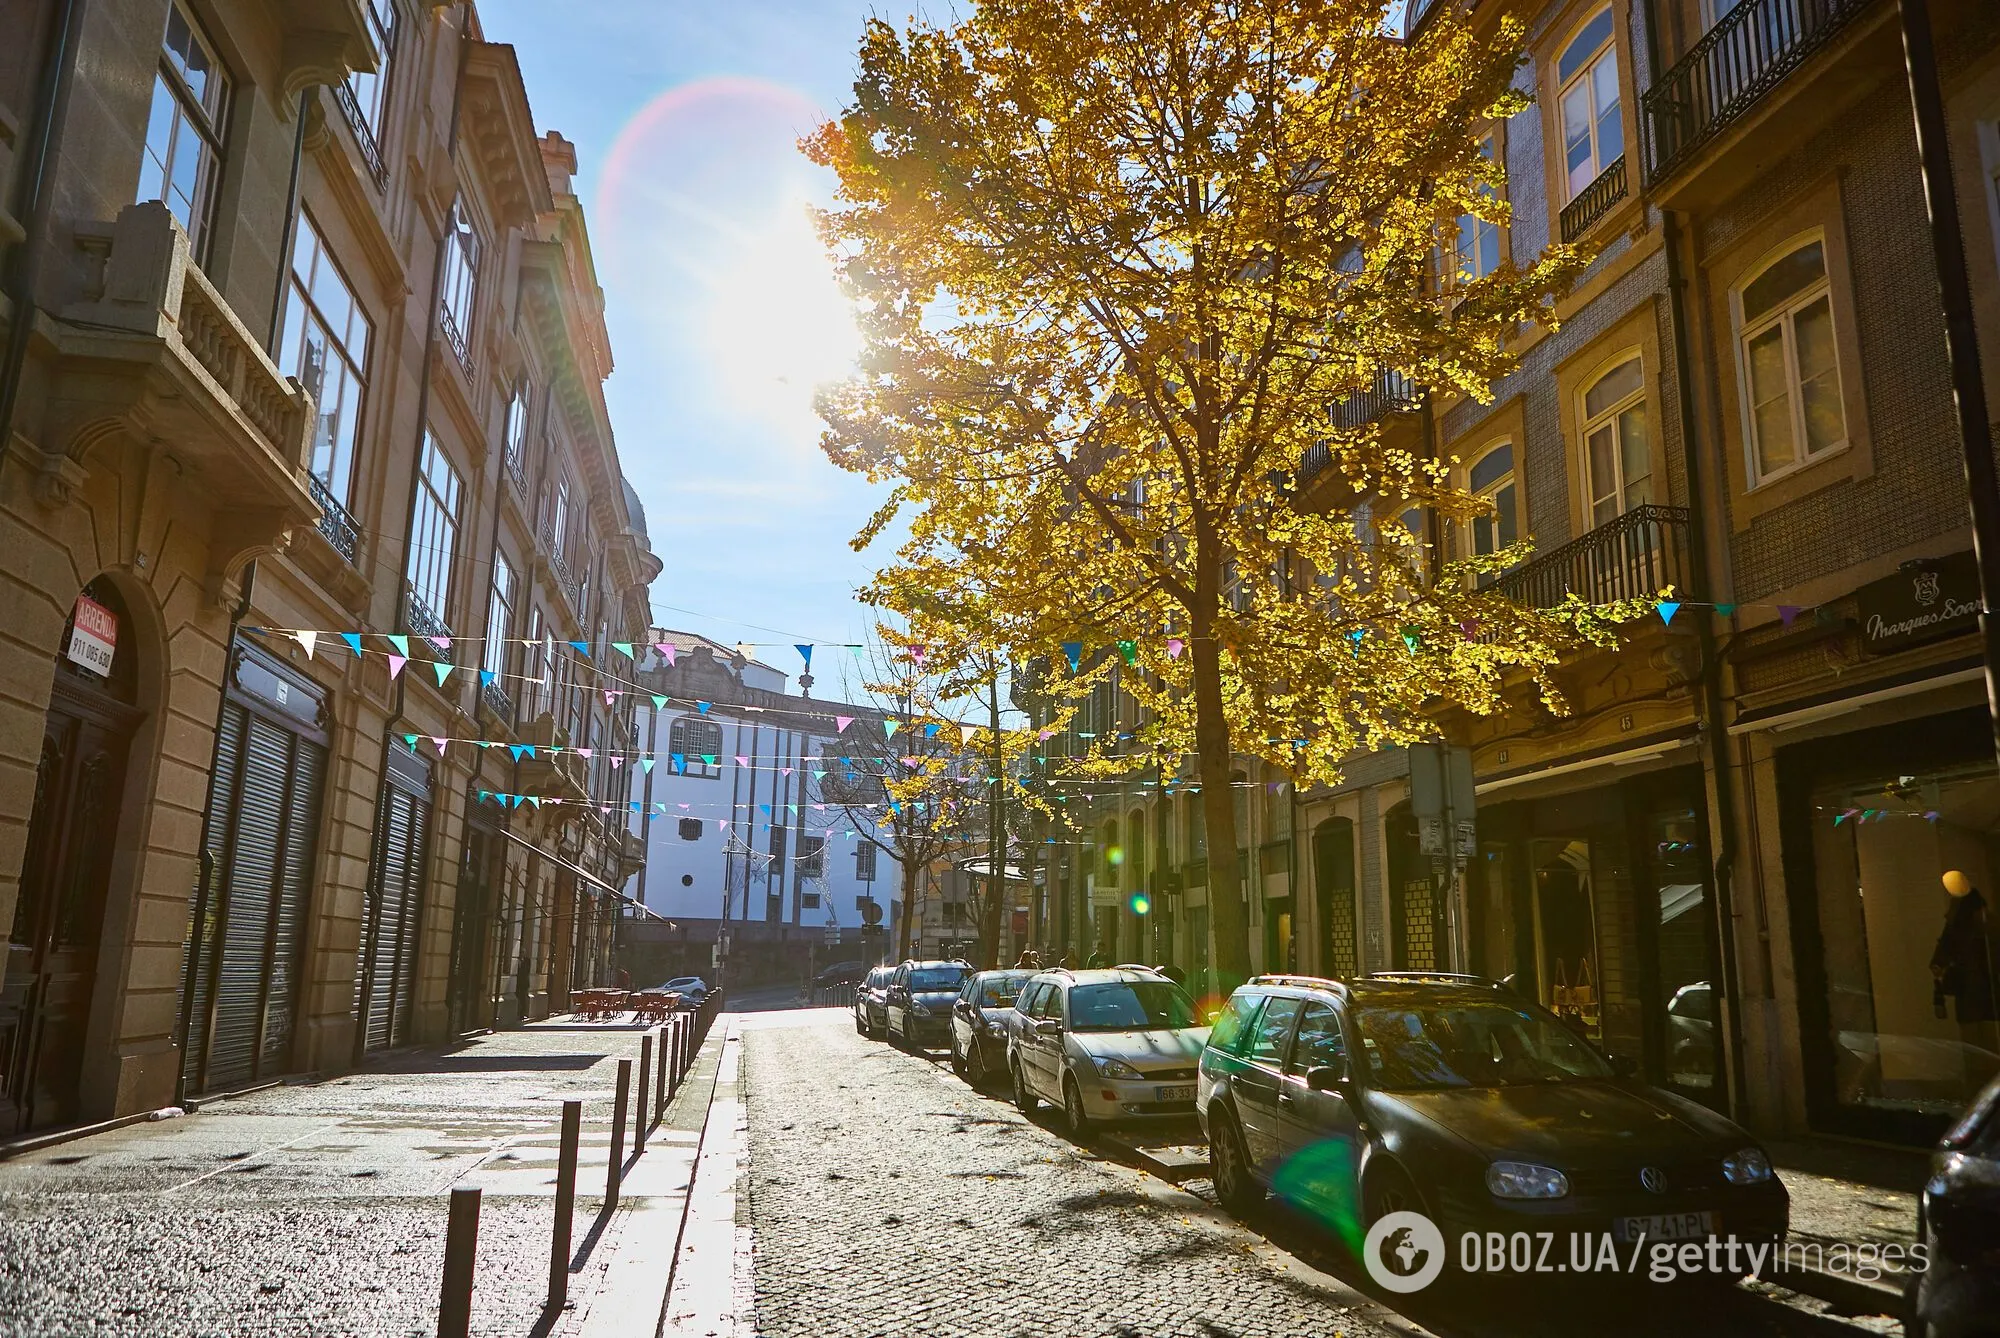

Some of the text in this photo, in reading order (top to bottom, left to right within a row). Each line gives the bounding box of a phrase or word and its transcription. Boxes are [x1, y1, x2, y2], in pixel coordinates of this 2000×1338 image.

[78, 602, 116, 641] ARRENDA
[1867, 614, 1938, 640] Marques
[72, 637, 86, 656] 911
